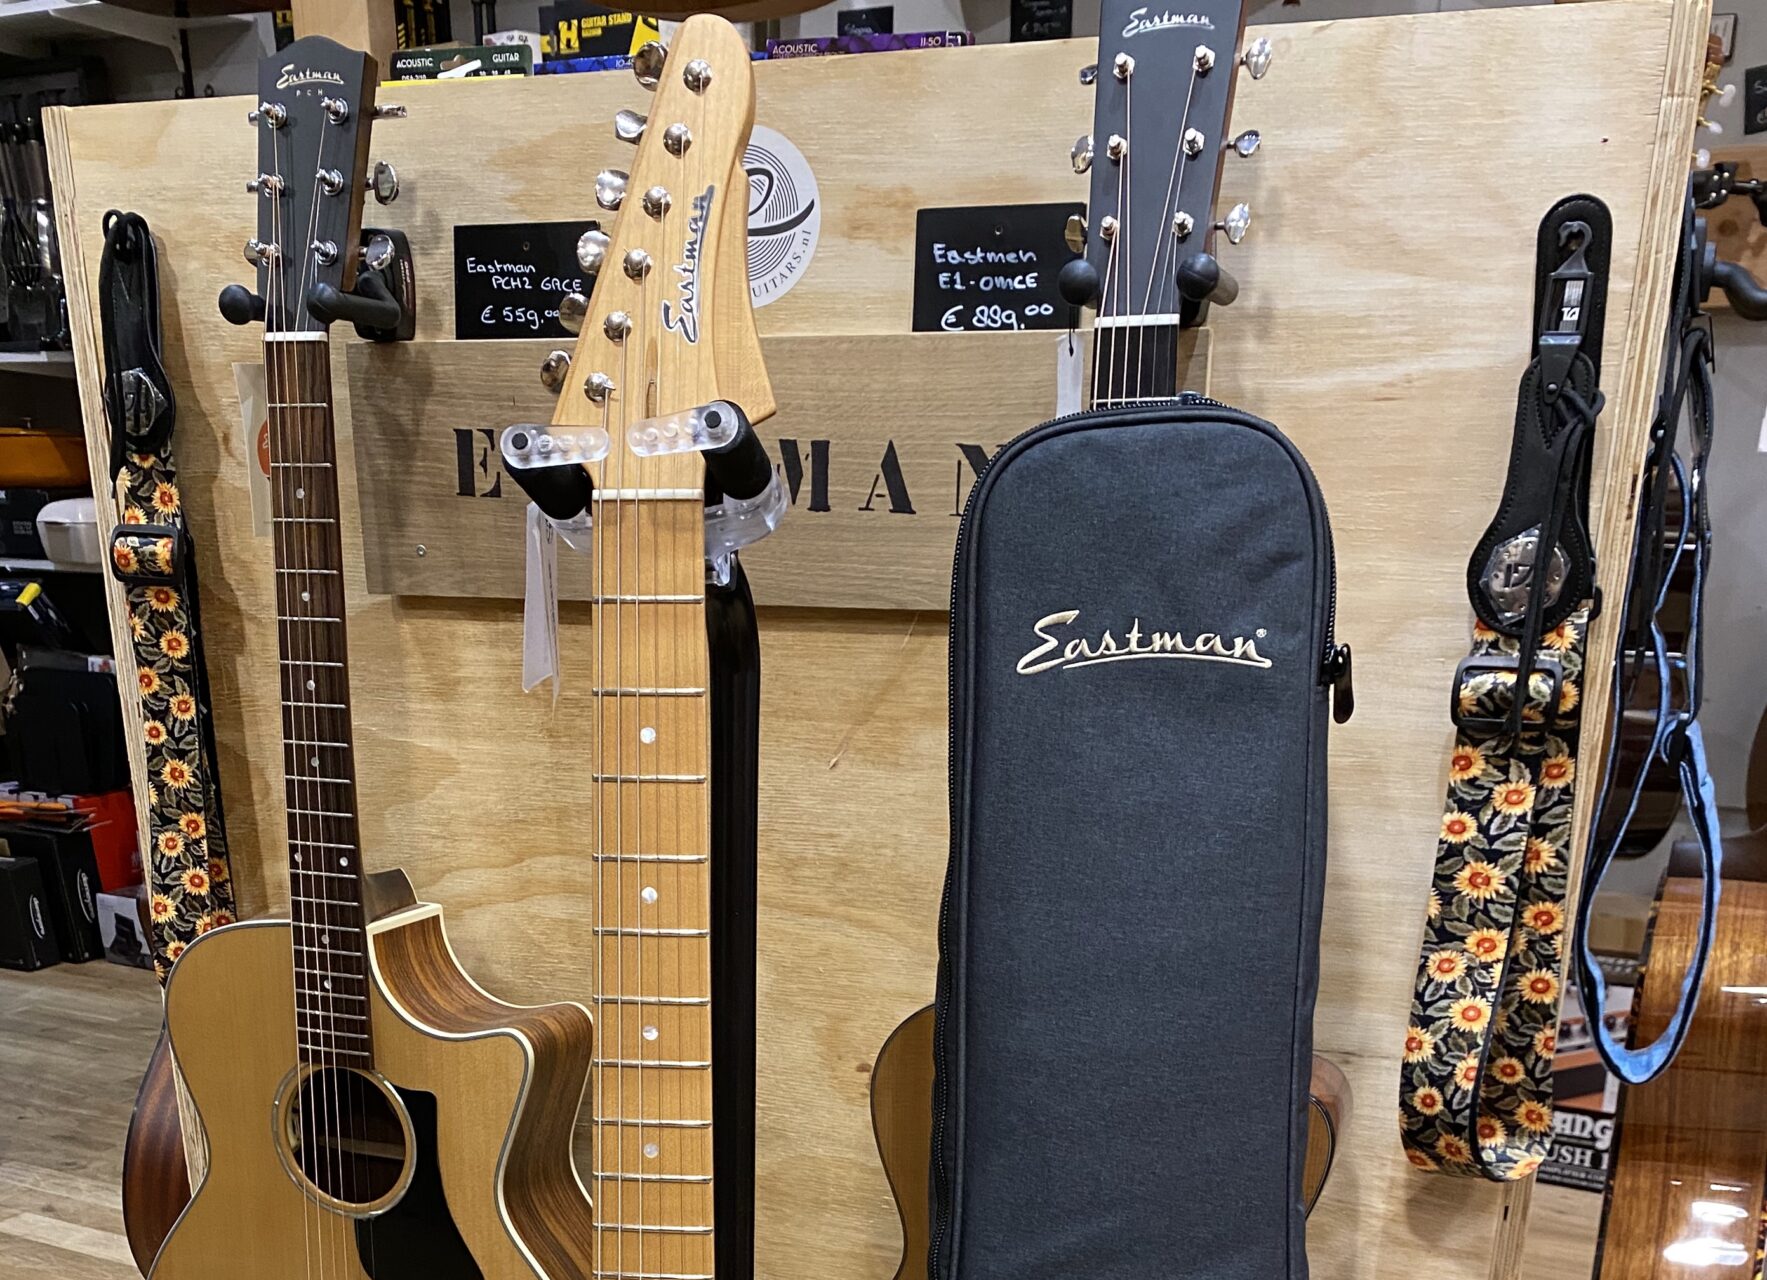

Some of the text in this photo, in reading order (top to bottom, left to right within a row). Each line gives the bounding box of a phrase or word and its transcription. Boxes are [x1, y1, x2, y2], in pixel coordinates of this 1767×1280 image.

[581, 12, 632, 28] GUITAR STAND
[1122, 7, 1215, 38] Eastman
[772, 43, 818, 54] ACOUSTIC
[396, 52, 519, 68] ACOUSTIC GUITAR
[277, 64, 344, 89] Eastman
[466, 257, 536, 274] Eastman
[662, 184, 715, 344] Eastman
[751, 229, 813, 298] UITARS.nl
[491, 275, 533, 290] PCH2
[1546, 1143, 1593, 1168] USH
